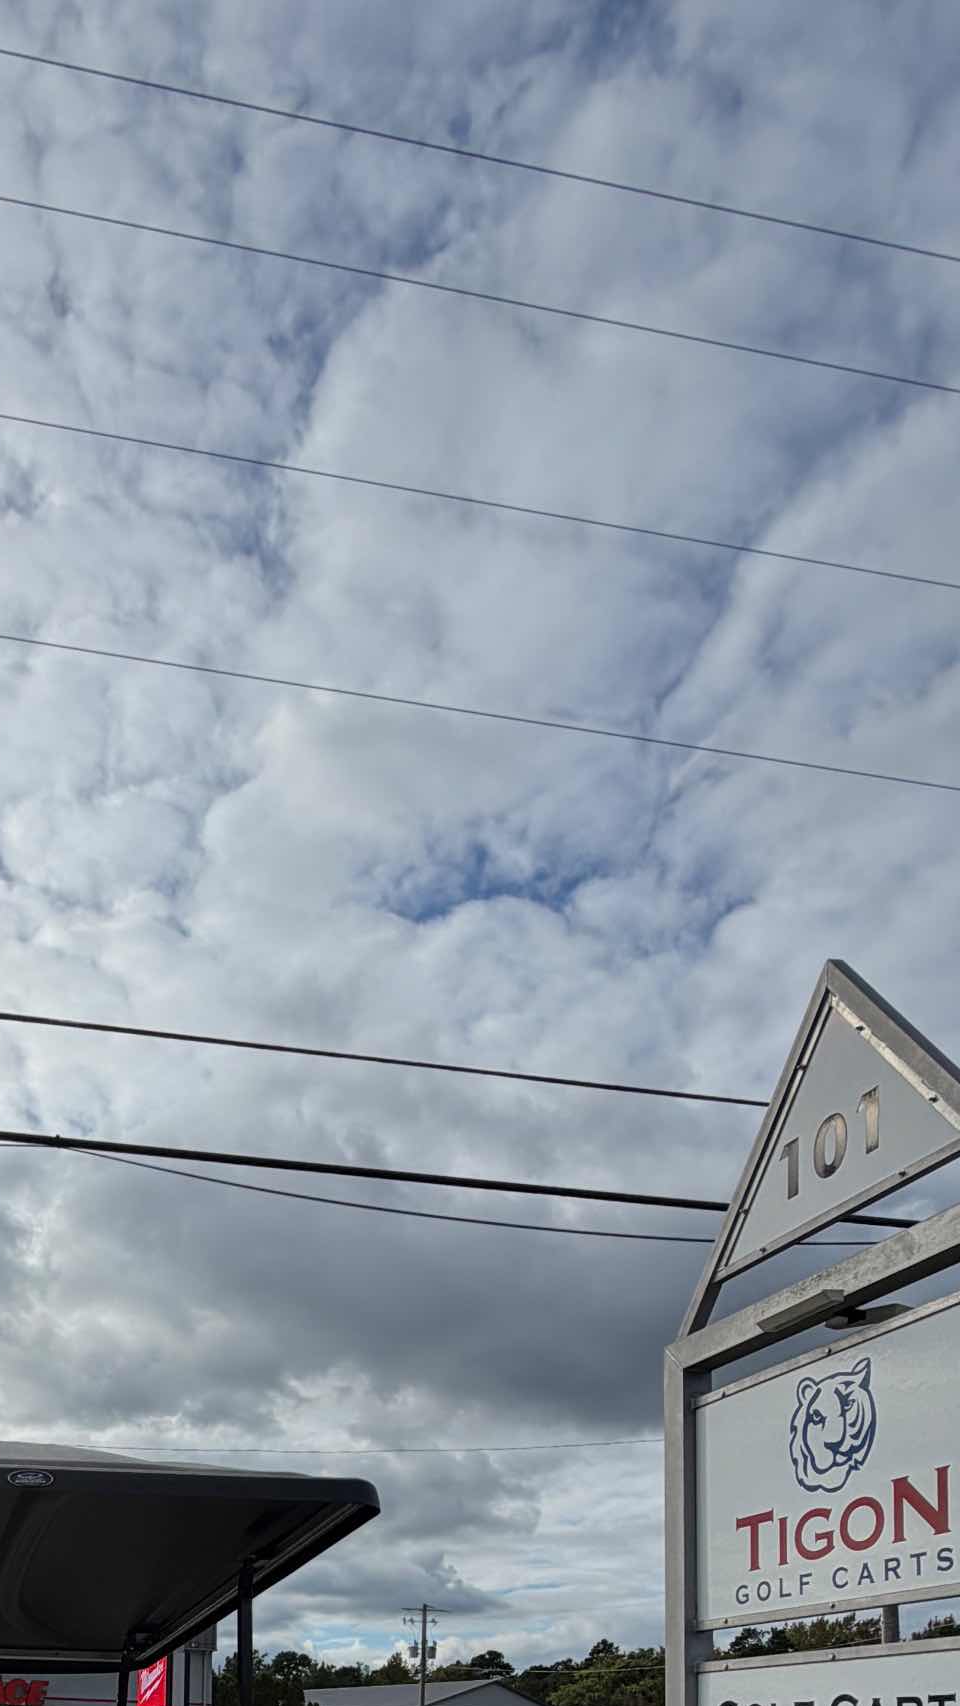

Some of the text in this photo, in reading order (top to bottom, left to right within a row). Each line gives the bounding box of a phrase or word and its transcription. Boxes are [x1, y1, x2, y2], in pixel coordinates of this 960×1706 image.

[778, 1084, 880, 1200] 101
[736, 1465, 951, 1571] TIGON
[735, 1547, 954, 1604] GOLF CARTS
